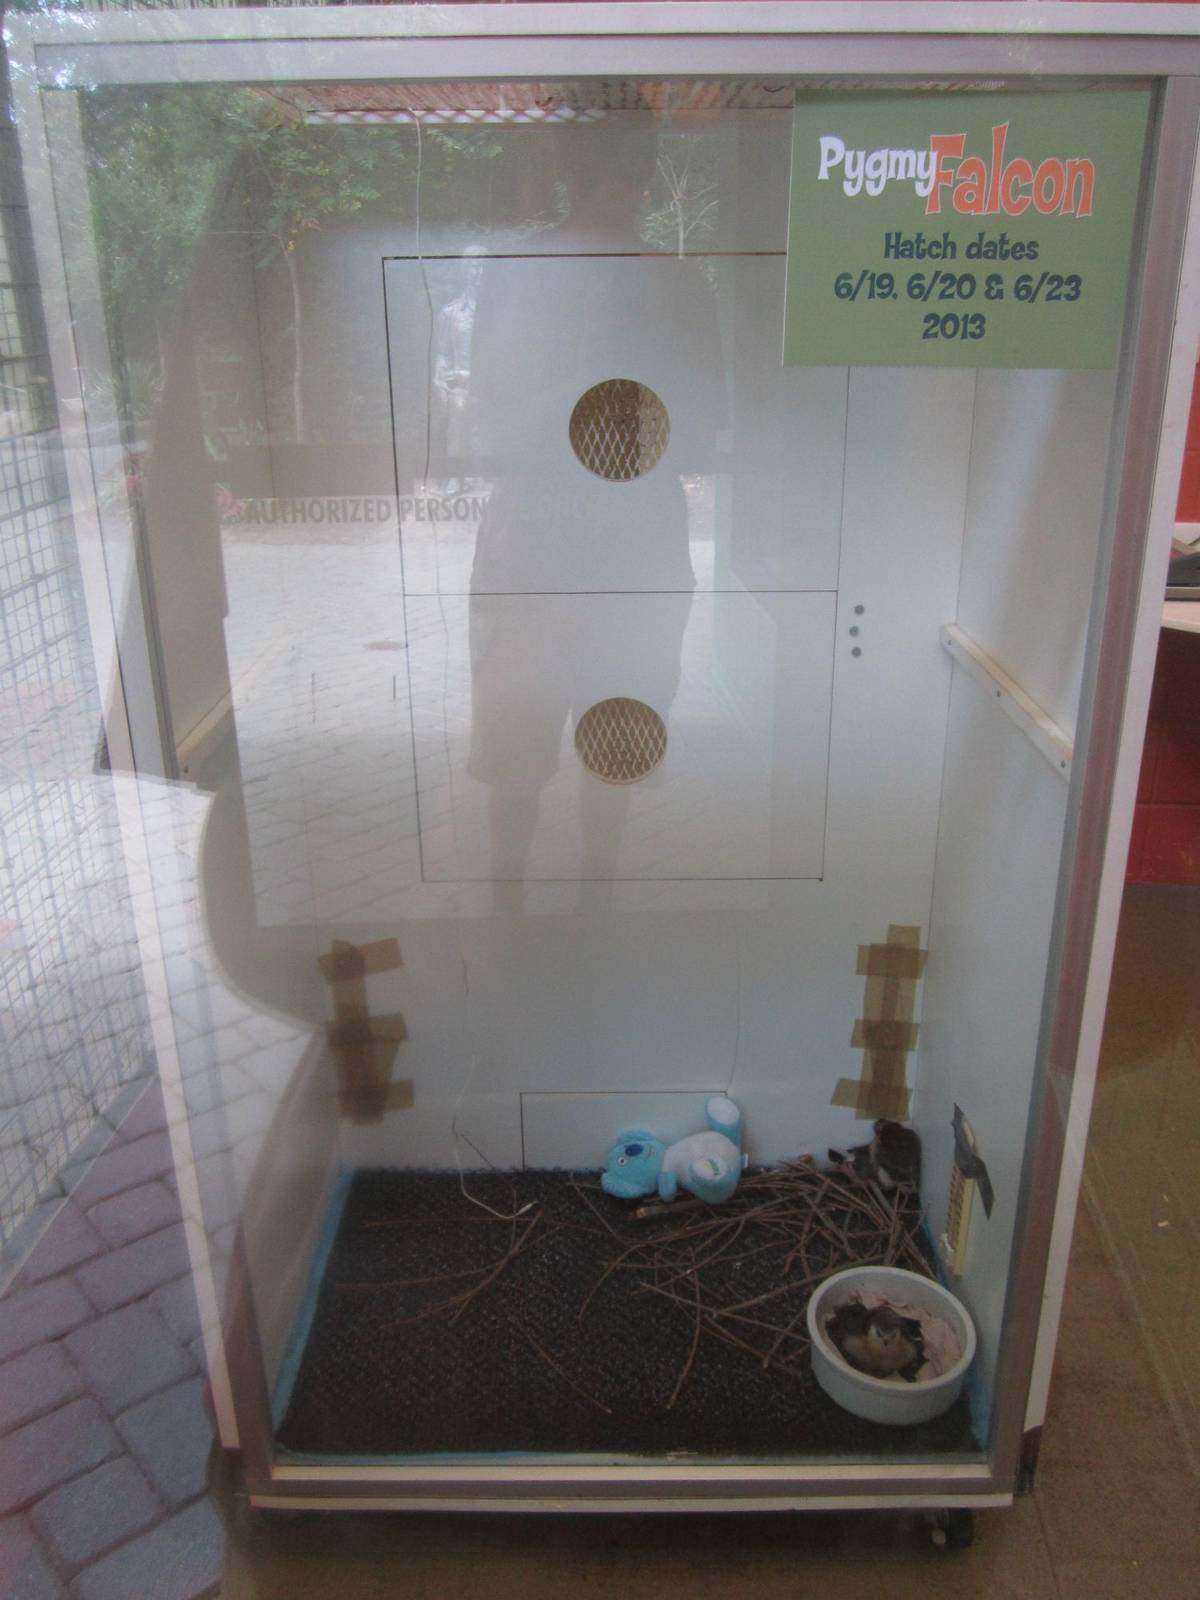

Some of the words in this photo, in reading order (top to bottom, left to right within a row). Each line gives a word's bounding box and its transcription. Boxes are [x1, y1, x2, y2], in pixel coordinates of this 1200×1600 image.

[817, 136, 938, 197] Pygmy
[925, 121, 1095, 218] Falcon
[883, 232, 957, 260] Hatch
[965, 232, 1040, 260] dates
[906, 270, 977, 301] 6/20
[984, 274, 1004, 300] &
[1013, 272, 1083, 303] 6/23
[922, 312, 987, 340] 2013
